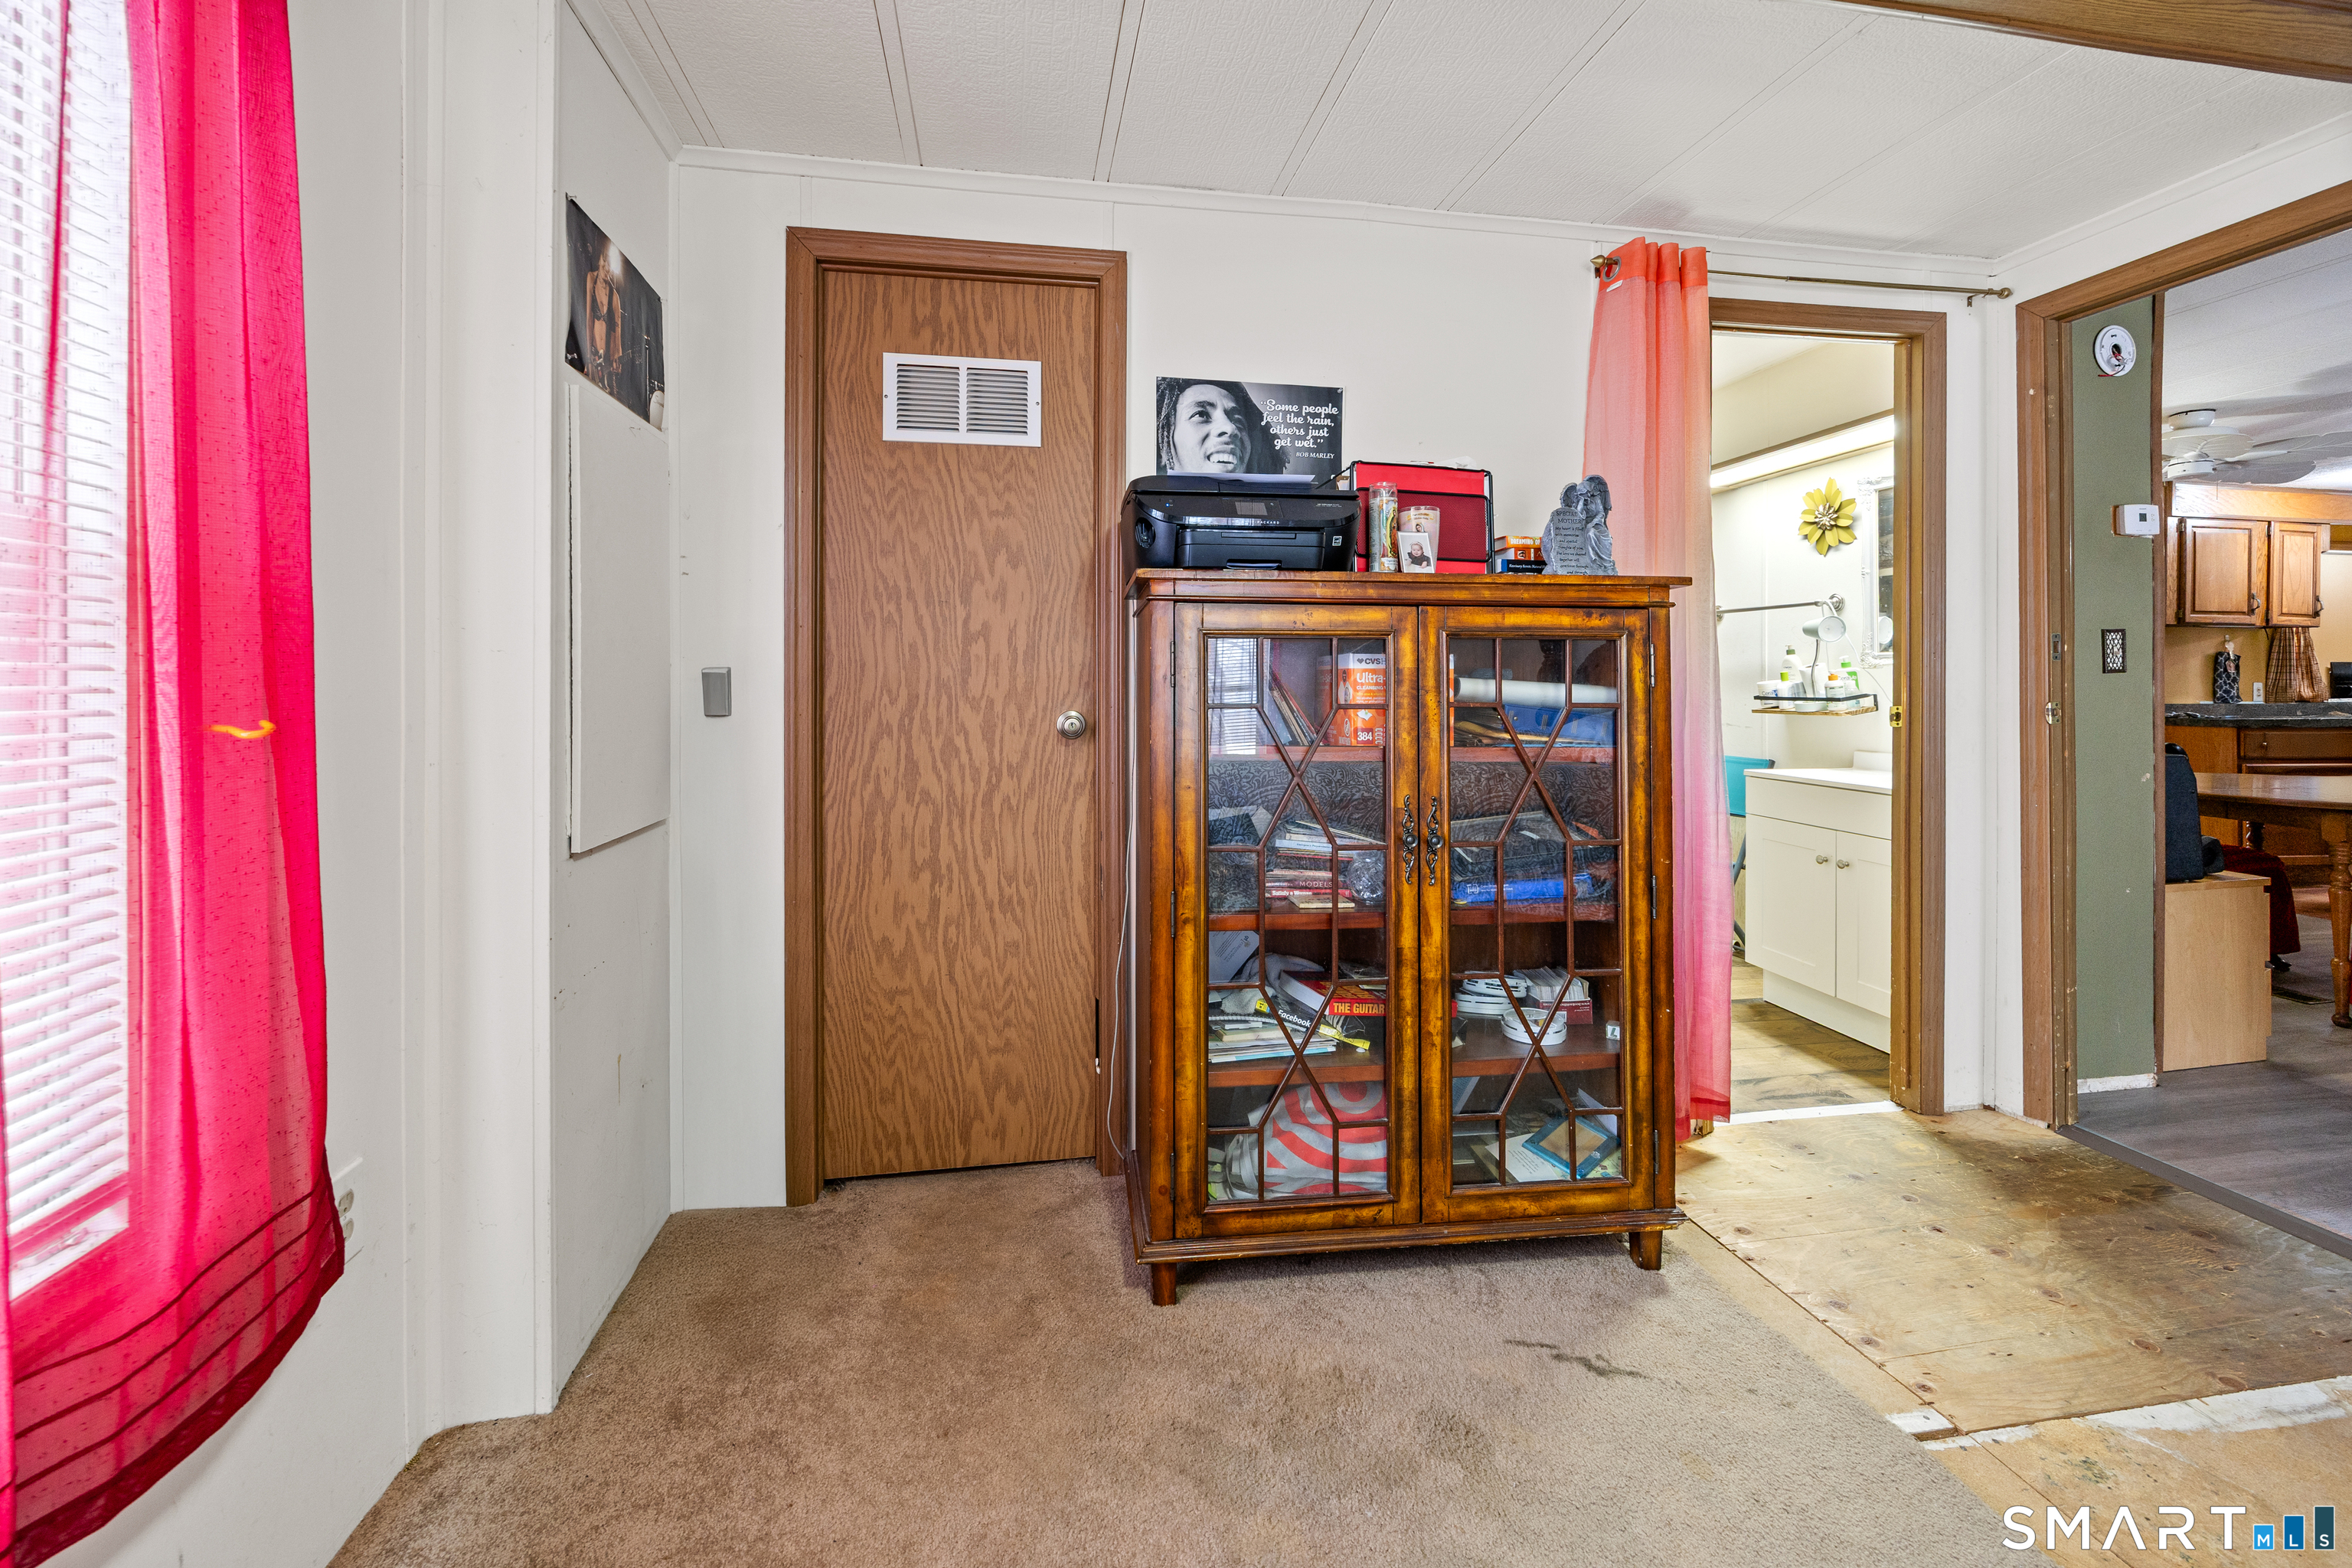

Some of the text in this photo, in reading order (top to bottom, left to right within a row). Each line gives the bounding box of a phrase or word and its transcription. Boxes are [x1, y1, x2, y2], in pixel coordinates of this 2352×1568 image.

[1302, 403, 1339, 418] people
[1261, 412, 1334, 427] feel the rain,
[1270, 424, 1329, 440] others just
[1274, 437, 1292, 450] get
[1357, 732, 1373, 741] 384
[1333, 1002, 1385, 1014] THE GUITAR
[1278, 1009, 1312, 1028] Facebook
